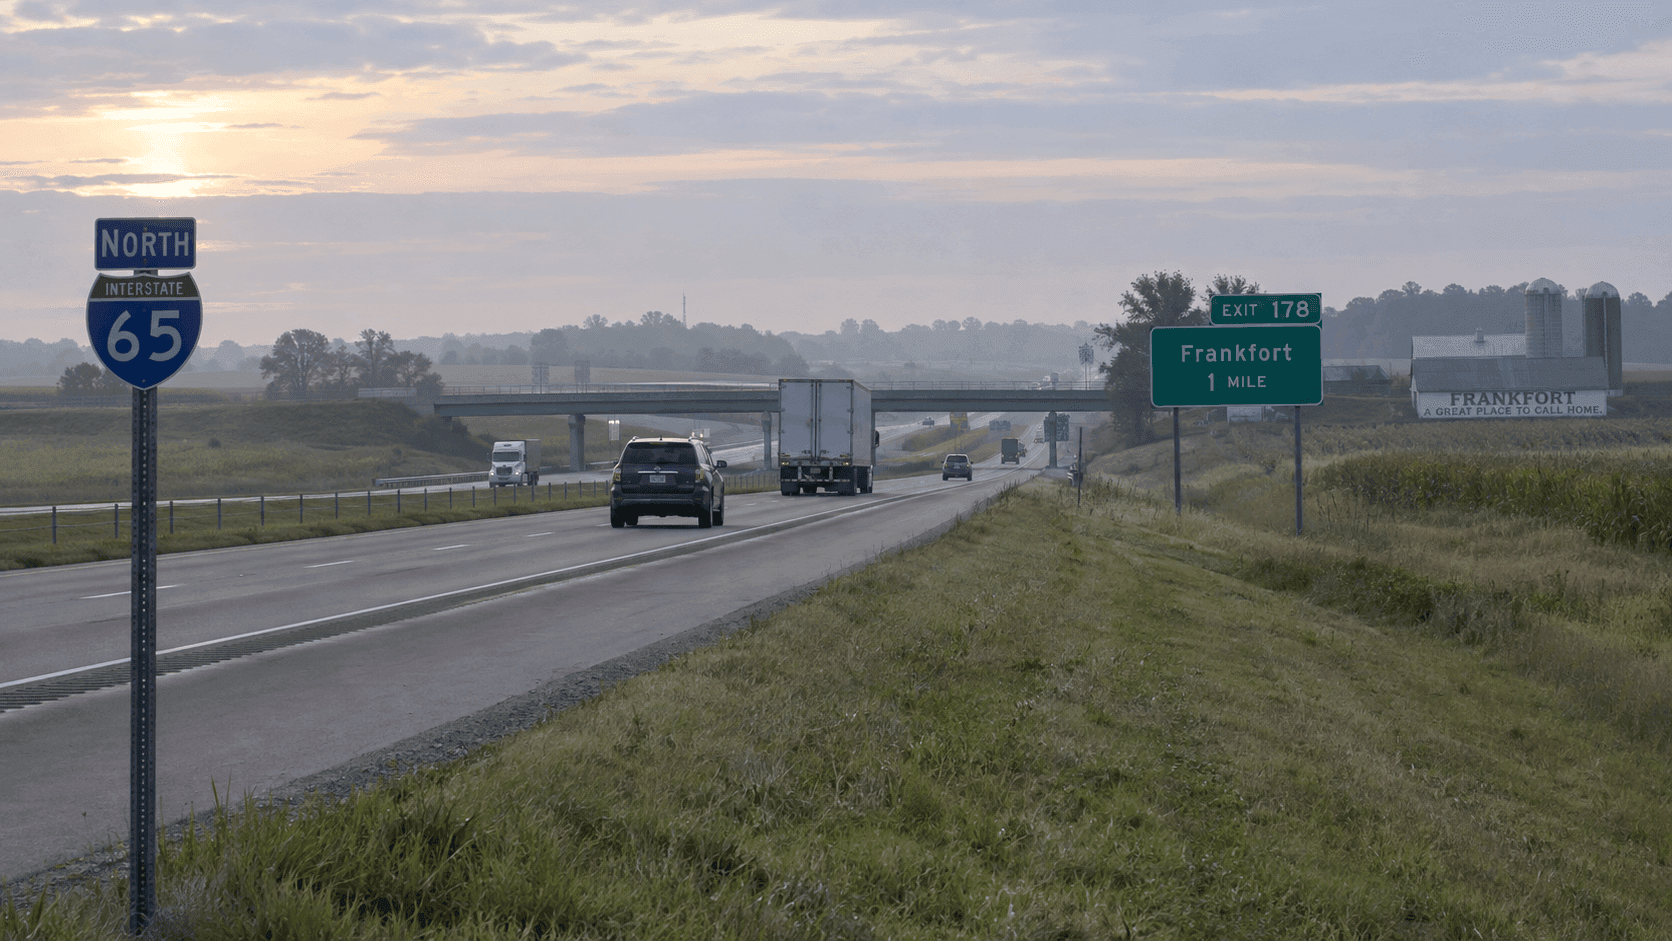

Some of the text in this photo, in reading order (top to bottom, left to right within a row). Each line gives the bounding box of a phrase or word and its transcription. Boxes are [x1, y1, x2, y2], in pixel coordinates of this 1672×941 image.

[101, 229, 190, 257] NORTH
[105, 282, 184, 296] INTERSTATE
[1222, 300, 1310, 319] EXIT 178
[107, 309, 182, 362] 65
[1181, 343, 1293, 363] Frankfort
[1207, 372, 1267, 392] 1 MILE
[1450, 391, 1576, 406] FRANKFORT
[1423, 405, 1603, 417] A GREAT PLACE TO CALL HOME.
